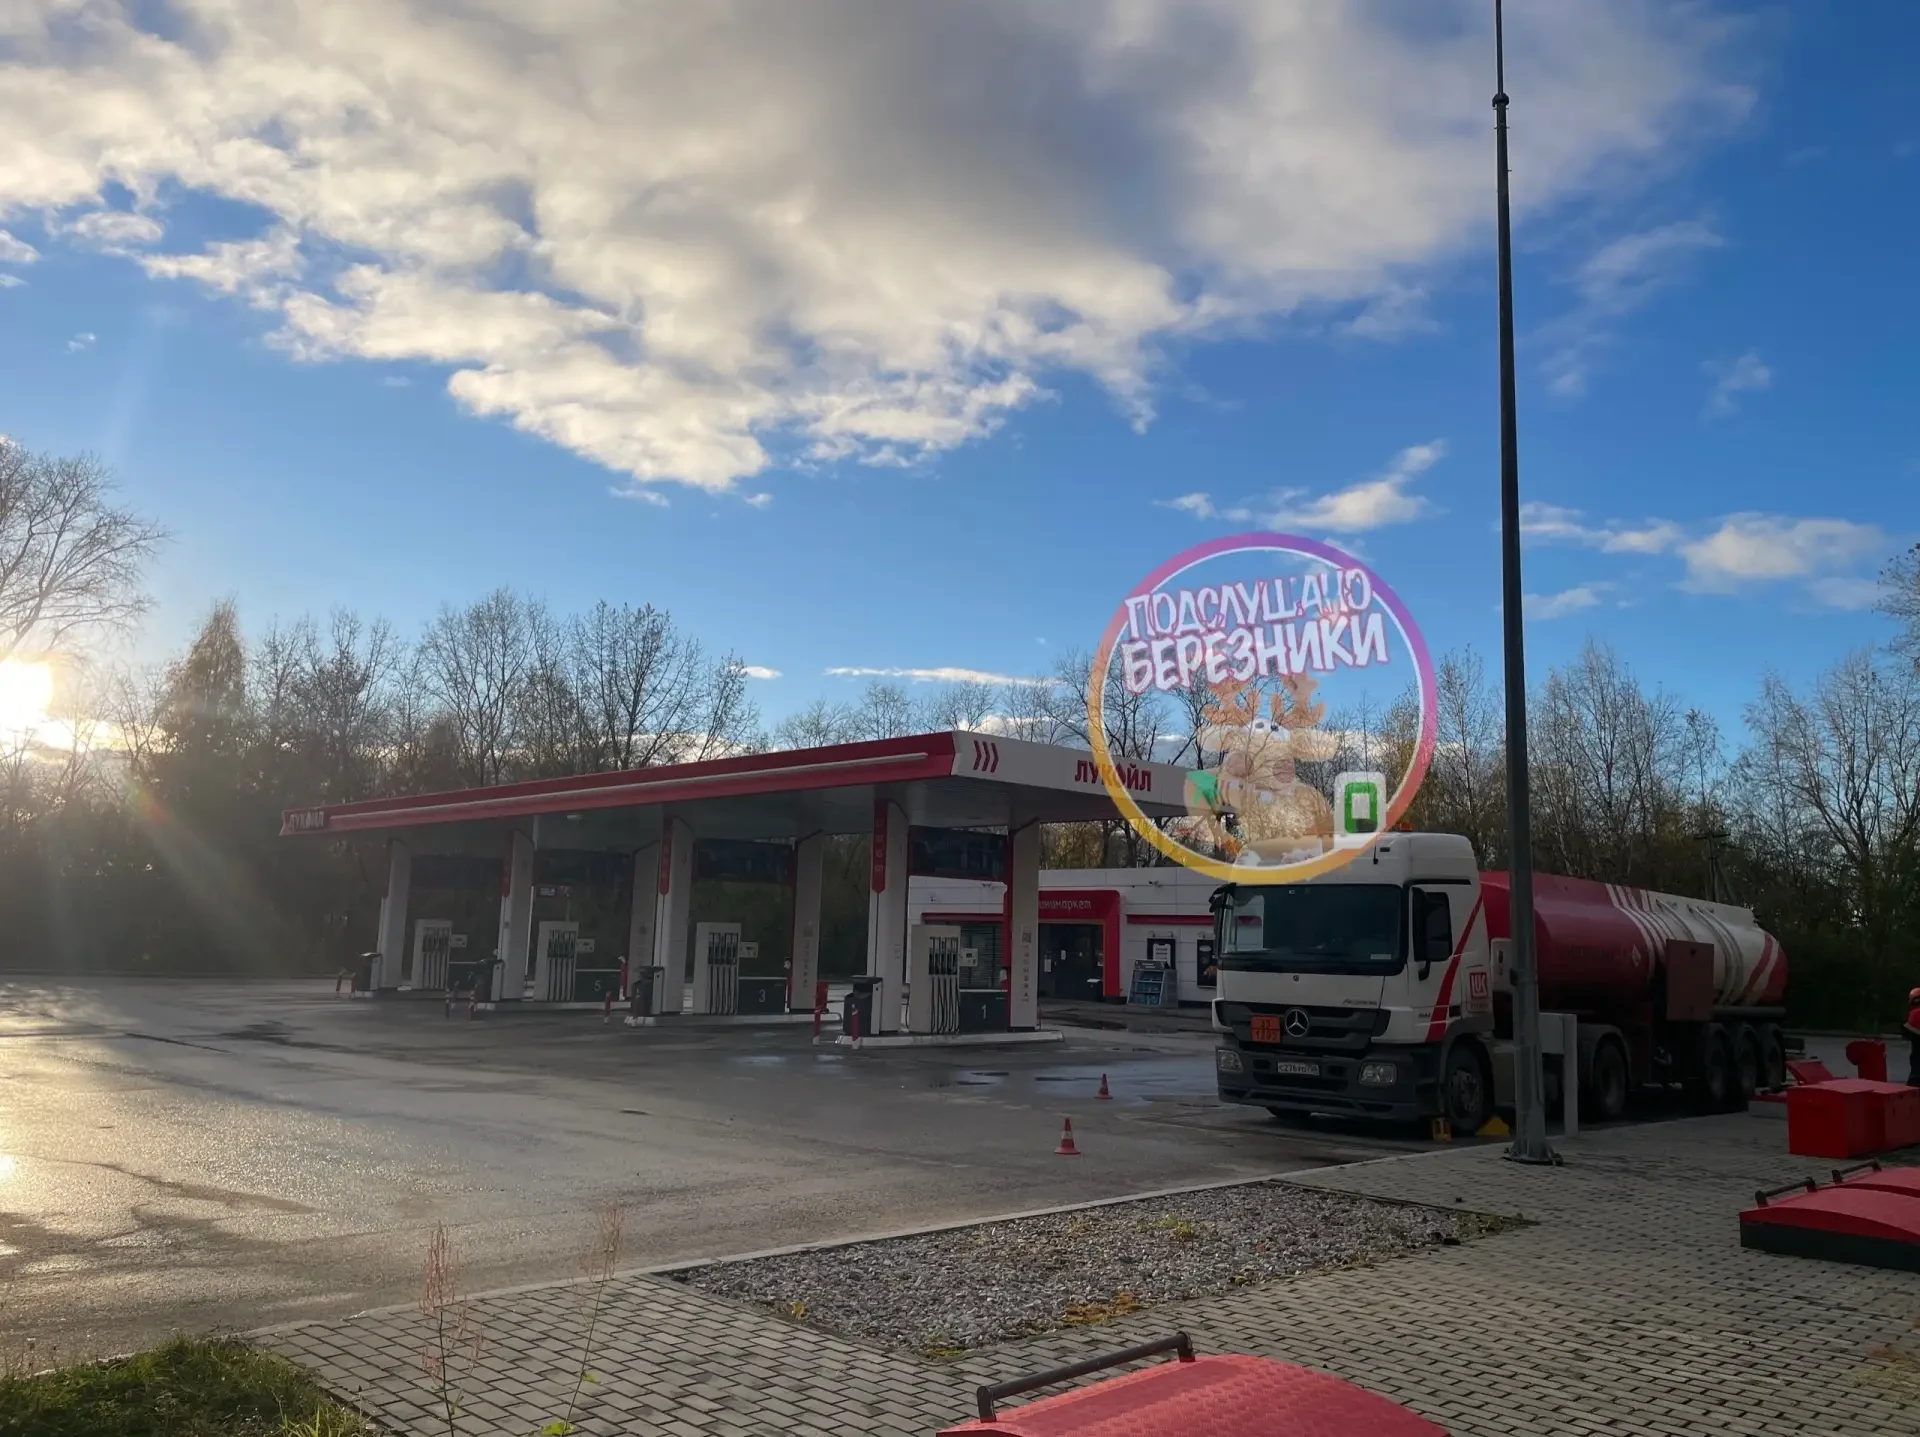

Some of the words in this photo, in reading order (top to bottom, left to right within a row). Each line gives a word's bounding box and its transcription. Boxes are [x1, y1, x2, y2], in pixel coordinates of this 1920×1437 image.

[1074, 759, 1151, 791] ЛУКОЙЛ
[1039, 900, 1092, 913] инимаркет
[593, 980, 603, 992] 5
[759, 989, 767, 1003] 3
[981, 1003, 987, 1020] 1
